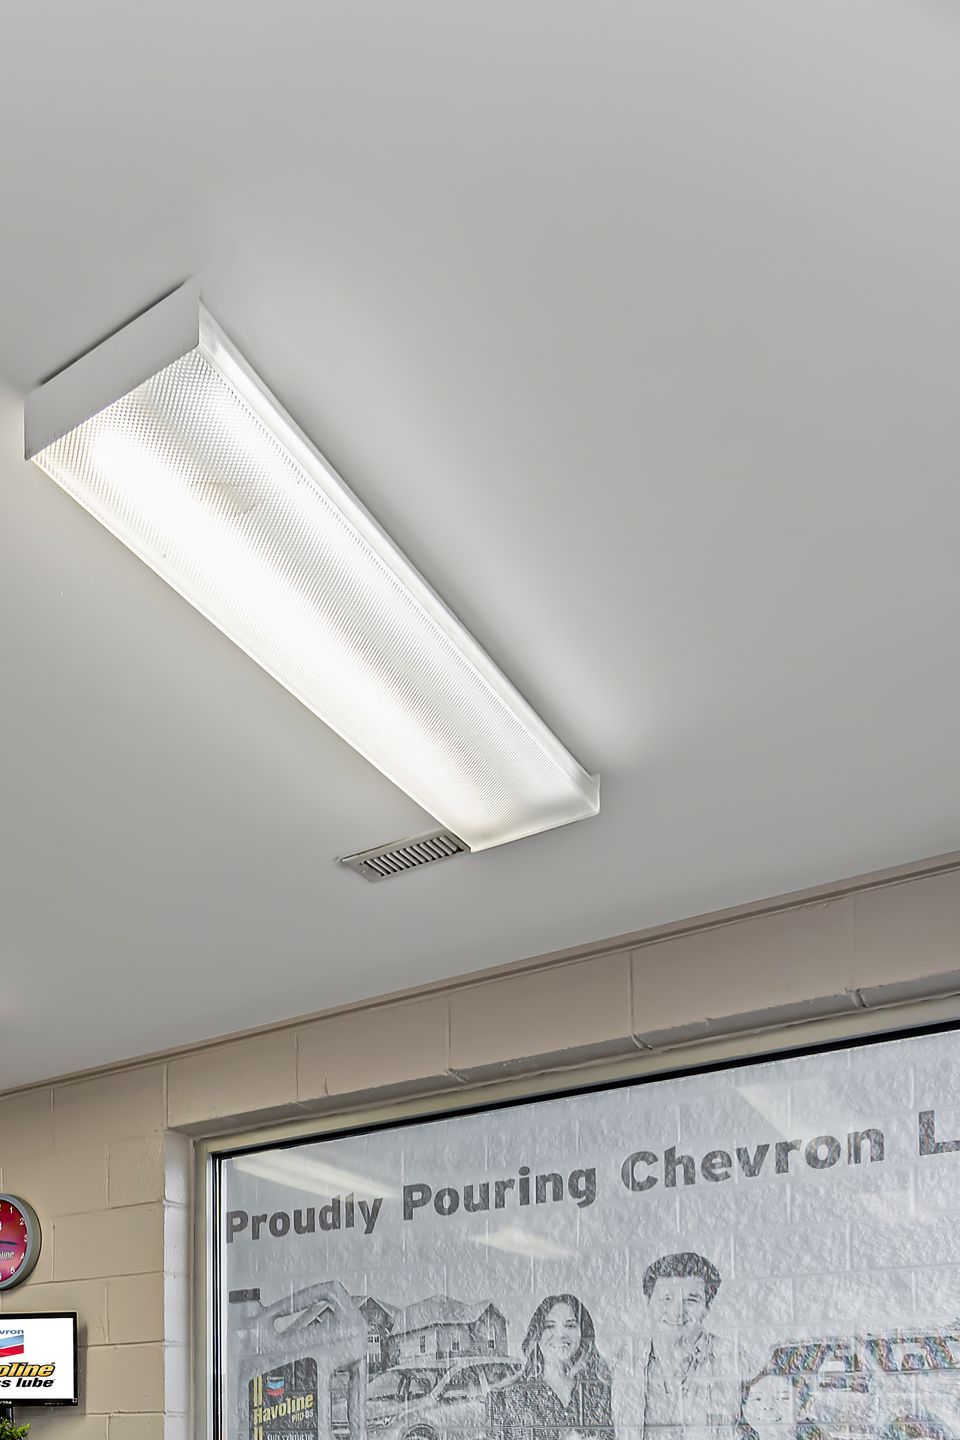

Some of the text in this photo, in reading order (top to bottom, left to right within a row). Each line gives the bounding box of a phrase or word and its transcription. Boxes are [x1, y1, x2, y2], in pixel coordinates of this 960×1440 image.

[226, 1192, 384, 1244] Proudly
[402, 1165, 597, 1221] Pouring
[620, 1127, 885, 1192] Chevron
[9, 1206, 13, 1214] 1
[15, 1377, 54, 1388] lube
[252, 1393, 314, 1425] Havoline
